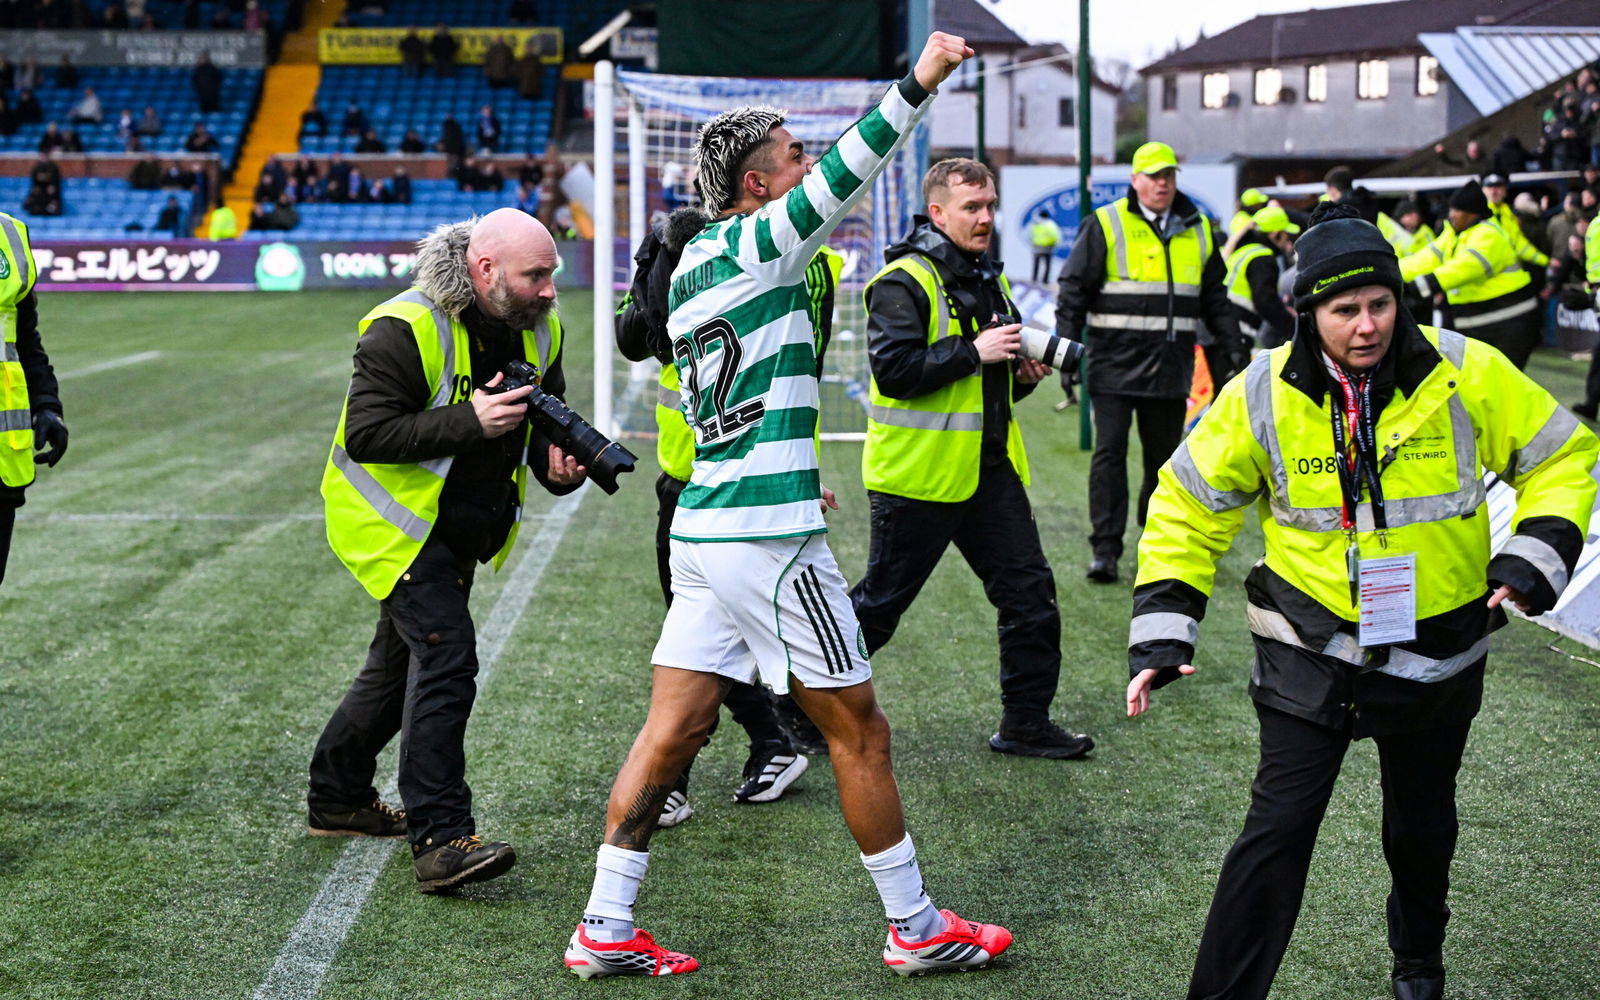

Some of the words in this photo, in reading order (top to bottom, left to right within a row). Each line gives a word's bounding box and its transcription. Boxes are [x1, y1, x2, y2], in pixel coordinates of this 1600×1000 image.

[320, 252, 389, 279] 100%
[673, 317, 766, 446] 22
[1363, 383, 1372, 418] PROTECTION
[1335, 420, 1343, 441] SAFETY
[1366, 425, 1374, 447] SAFETY
[1292, 456, 1337, 476] 098
